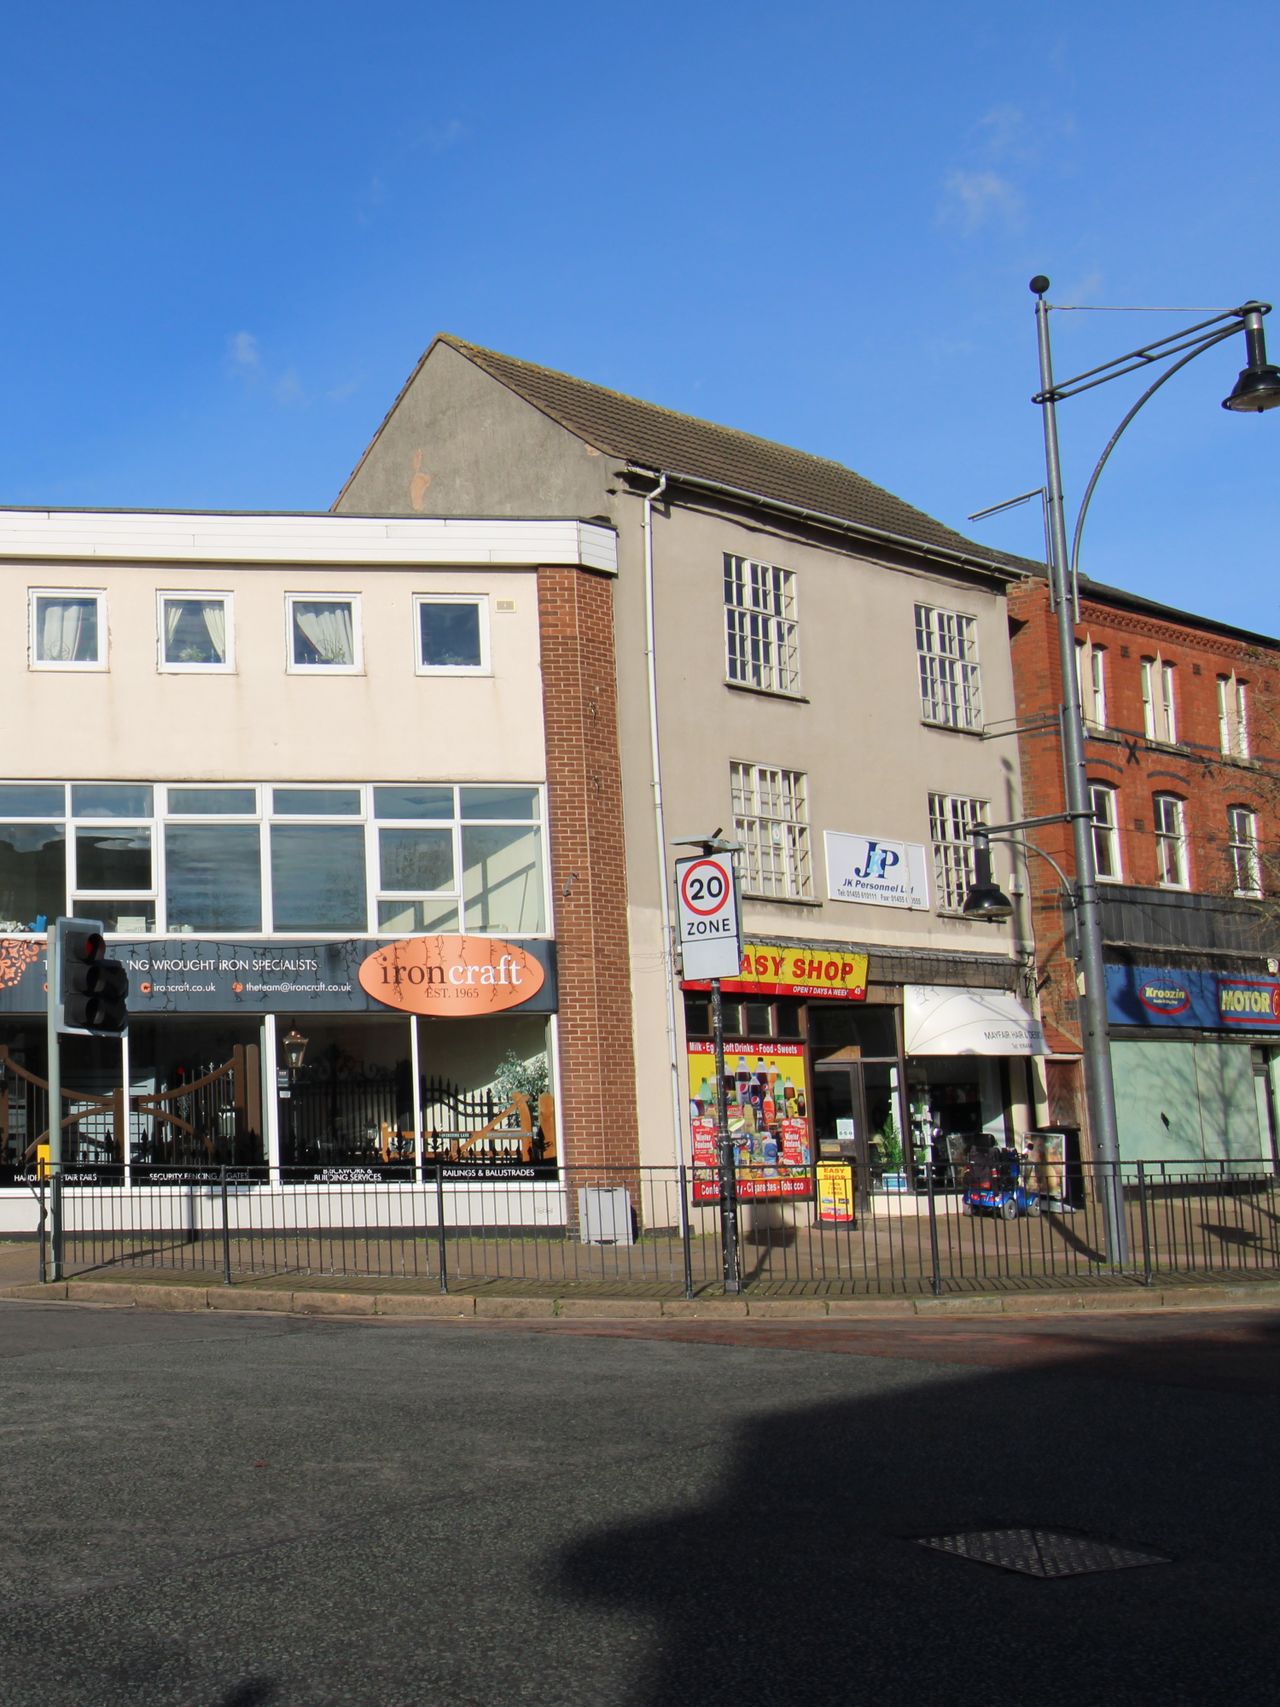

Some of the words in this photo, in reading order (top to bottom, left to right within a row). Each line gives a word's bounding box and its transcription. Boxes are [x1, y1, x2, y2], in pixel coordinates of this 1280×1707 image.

[689, 876, 723, 900] 20
[843, 878, 854, 888] JK
[855, 880, 898, 892] Personnel
[687, 918, 731, 936] ZONE
[153, 960, 216, 970] WROUGHT
[219, 960, 248, 970] IRON
[252, 960, 318, 970] SPECIALISTS
[380, 954, 522, 985] ironcraft
[740, 954, 784, 977] ASY
[792, 958, 854, 982] SHOP
[154, 982, 216, 992] ironcraft.co.uk
[246, 982, 352, 992] theteam@ironcraft.co.uk
[426, 988, 450, 998] EST.
[455, 988, 479, 998] 1965
[1145, 986, 1184, 998] Kroozin
[1221, 990, 1270, 1012] MOTOR
[690, 1041, 702, 1052] Milk
[734, 1042, 754, 1053] Drinks
[759, 1044, 773, 1053] Food
[777, 1044, 797, 1054] Sweets
